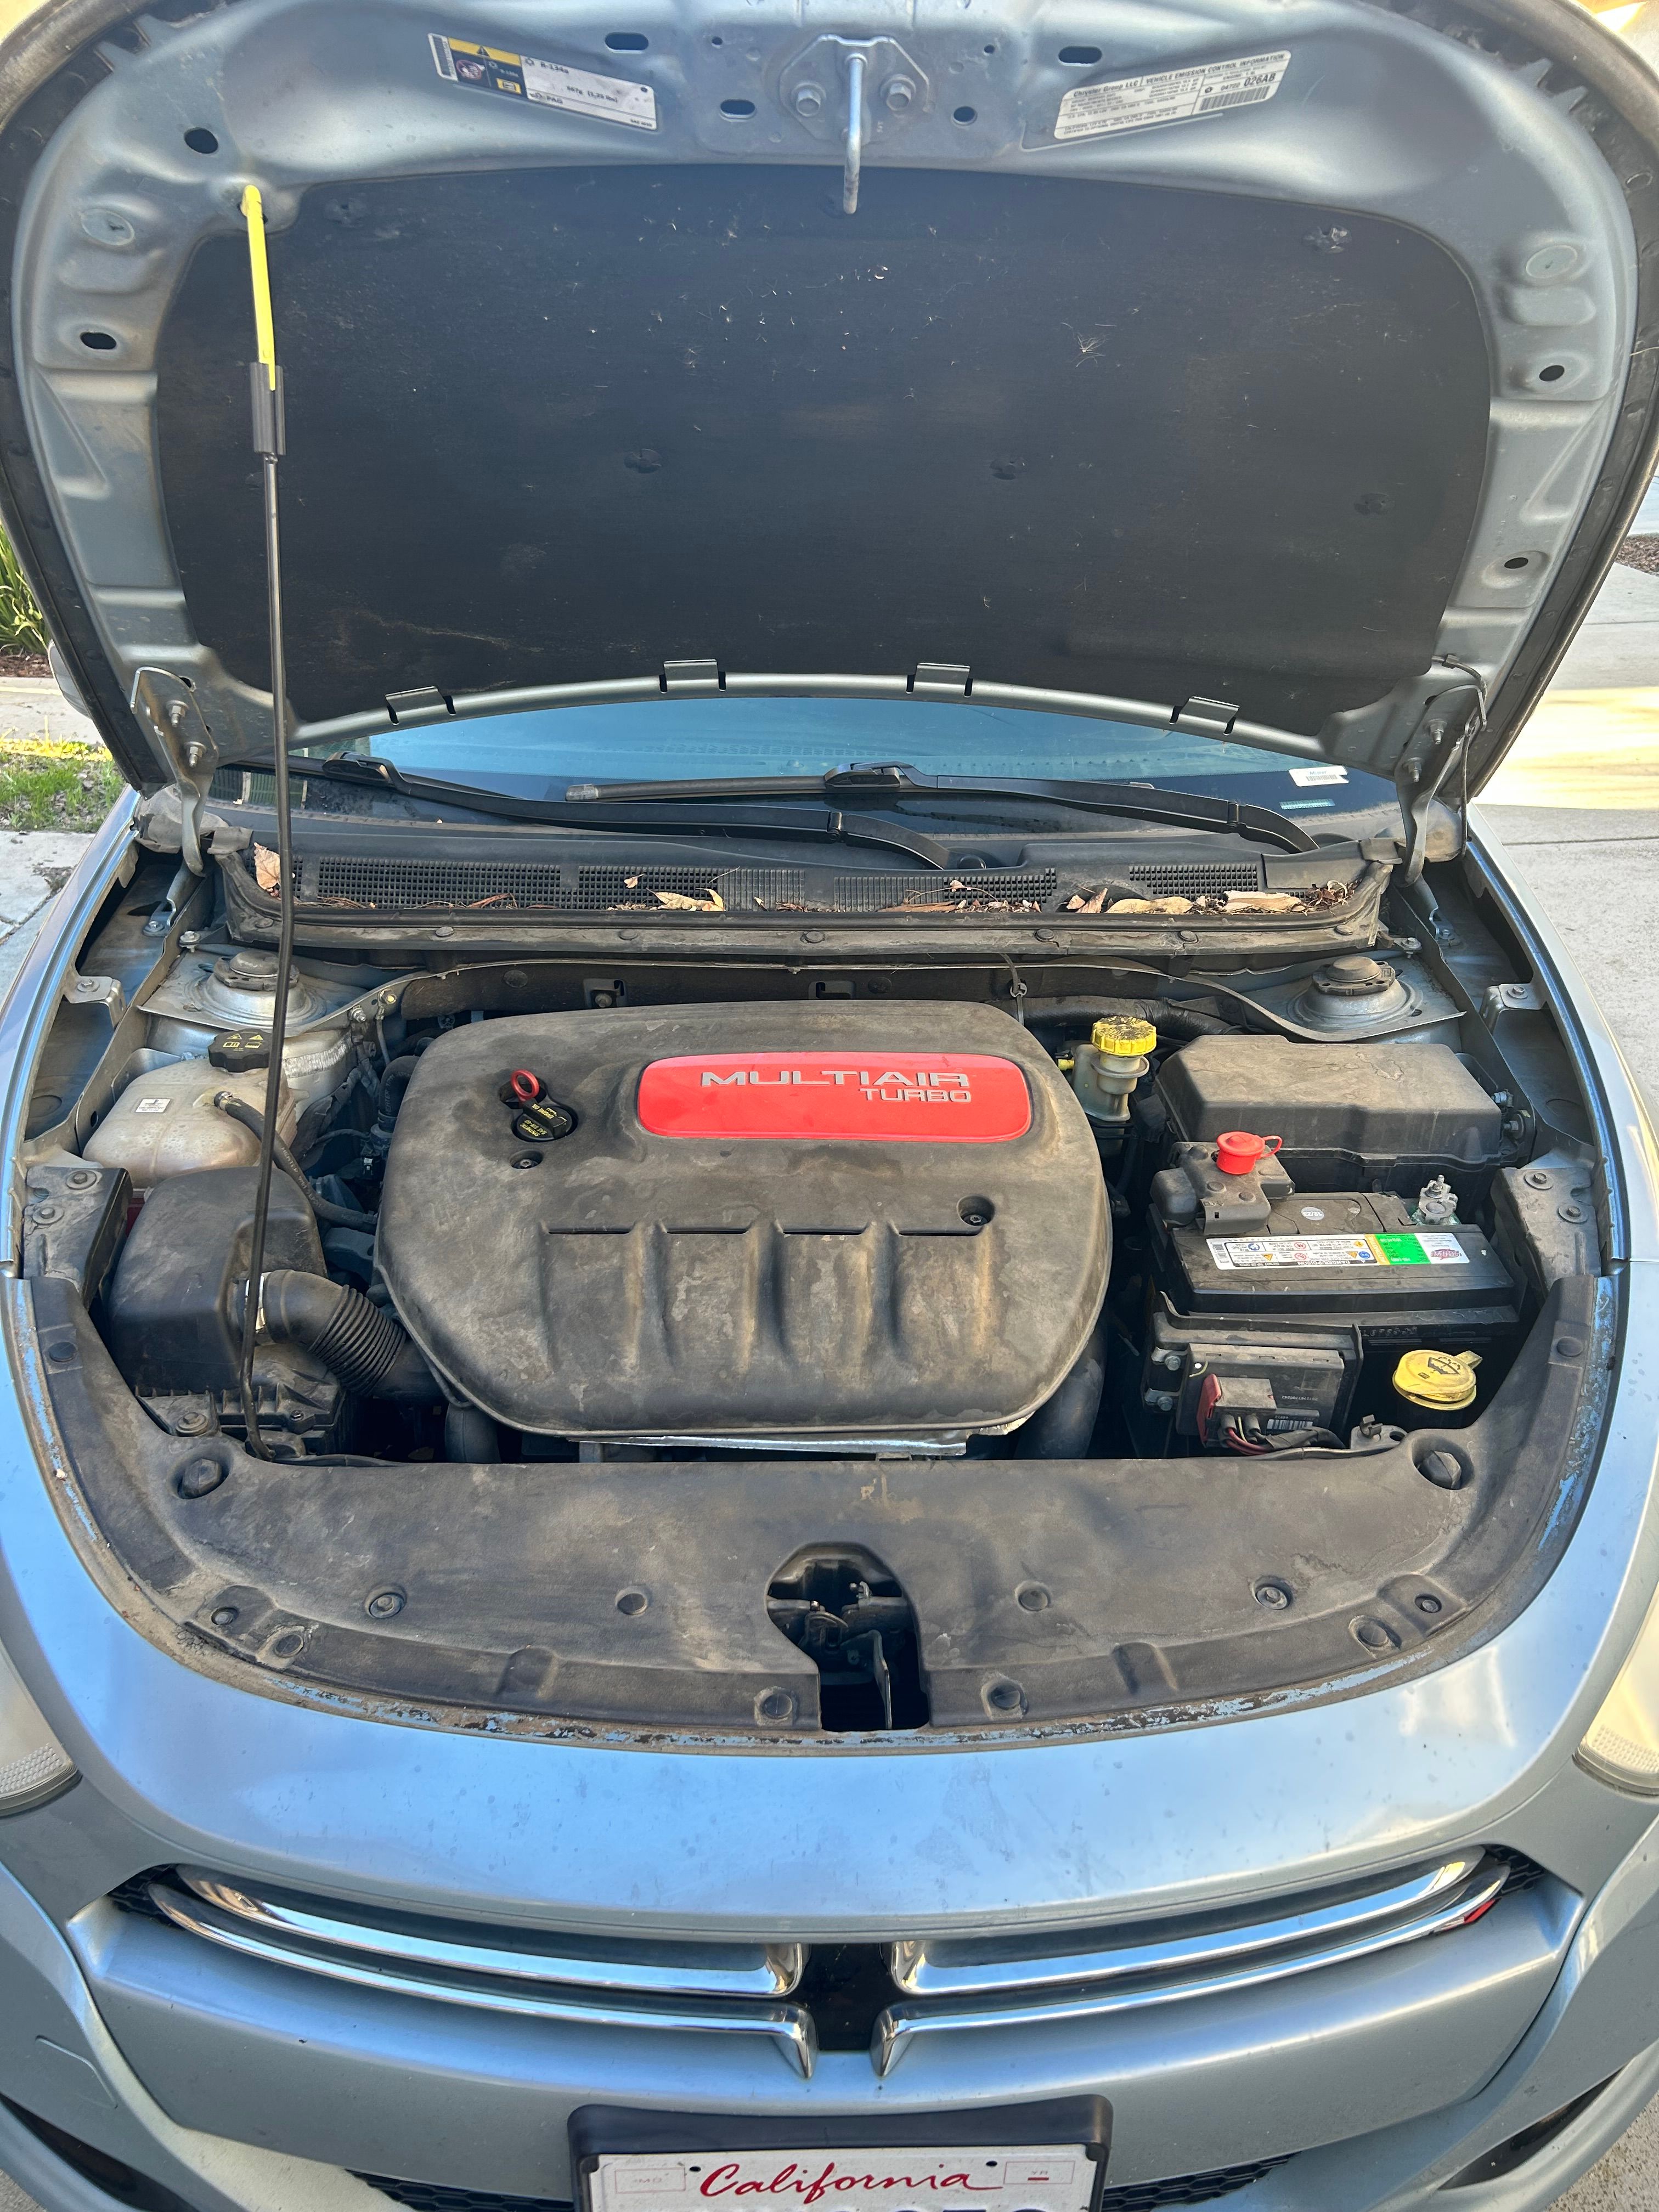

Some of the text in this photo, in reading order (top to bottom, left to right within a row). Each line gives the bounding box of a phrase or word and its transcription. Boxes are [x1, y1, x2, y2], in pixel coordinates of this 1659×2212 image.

[1147, 74, 1172, 84] VEHICLE
[1175, 68, 1206, 78] EMISSION
[1208, 63, 1237, 73] CONTROL
[1240, 53, 1285, 67] INFORMATION
[1244, 72, 1276, 86] 026AB
[1074, 88, 1101, 98] Chrysler
[1103, 84, 1123, 93] Group
[701, 1071, 969, 1087] MULTIAIR
[859, 1088, 971, 1103] TURBO
[700, 2162, 1003, 2204] California
